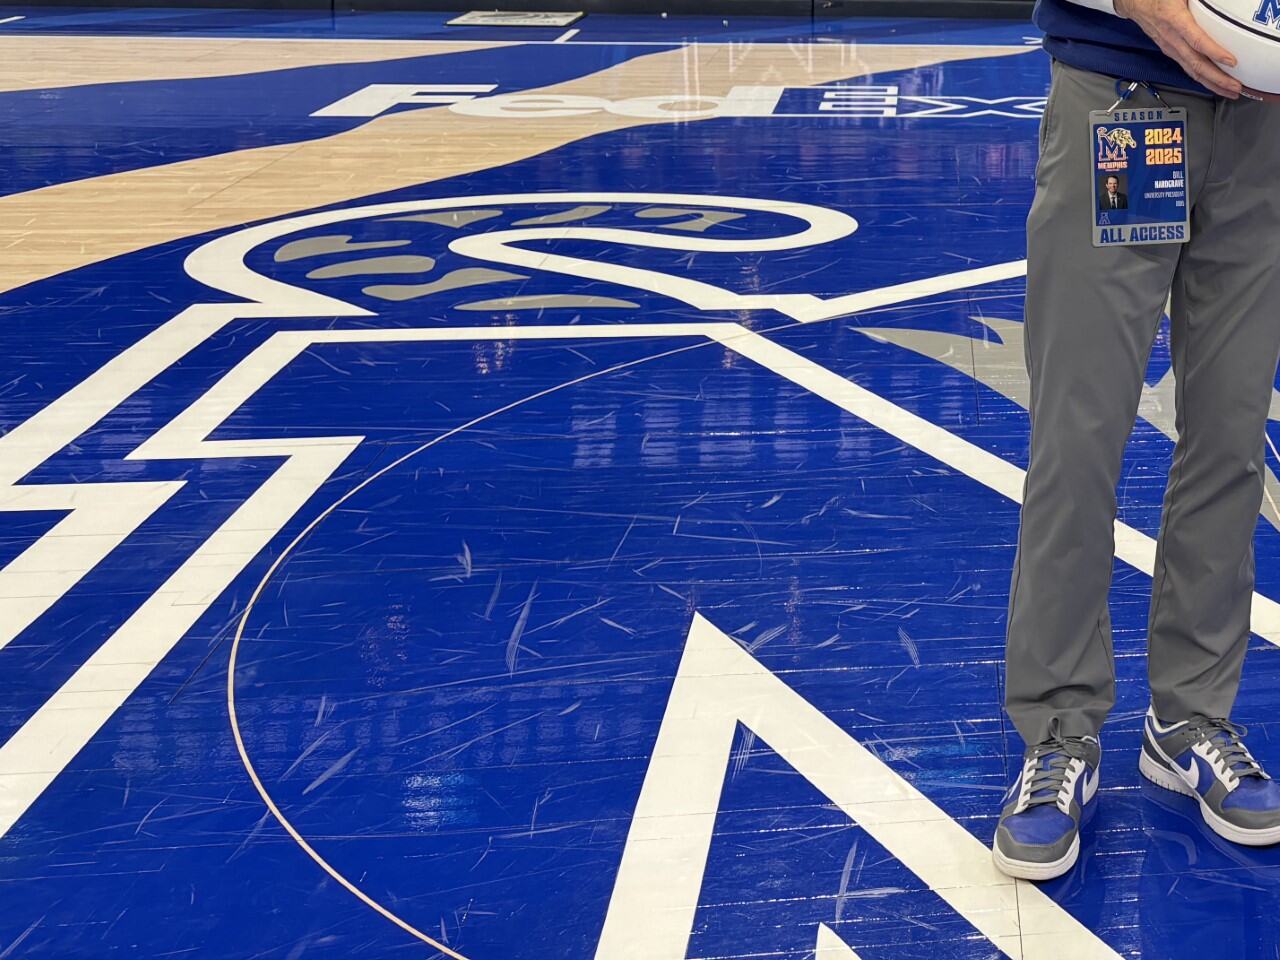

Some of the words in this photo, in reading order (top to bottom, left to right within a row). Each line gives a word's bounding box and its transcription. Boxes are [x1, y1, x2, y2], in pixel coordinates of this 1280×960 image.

[1114, 110, 1163, 122] SEASON
[1145, 127, 1182, 145] 2024
[1098, 161, 1128, 169] MEMPHIS
[1145, 148, 1182, 165] 2025
[1101, 227, 1125, 243] ALL
[1130, 225, 1184, 242] ACCESS
